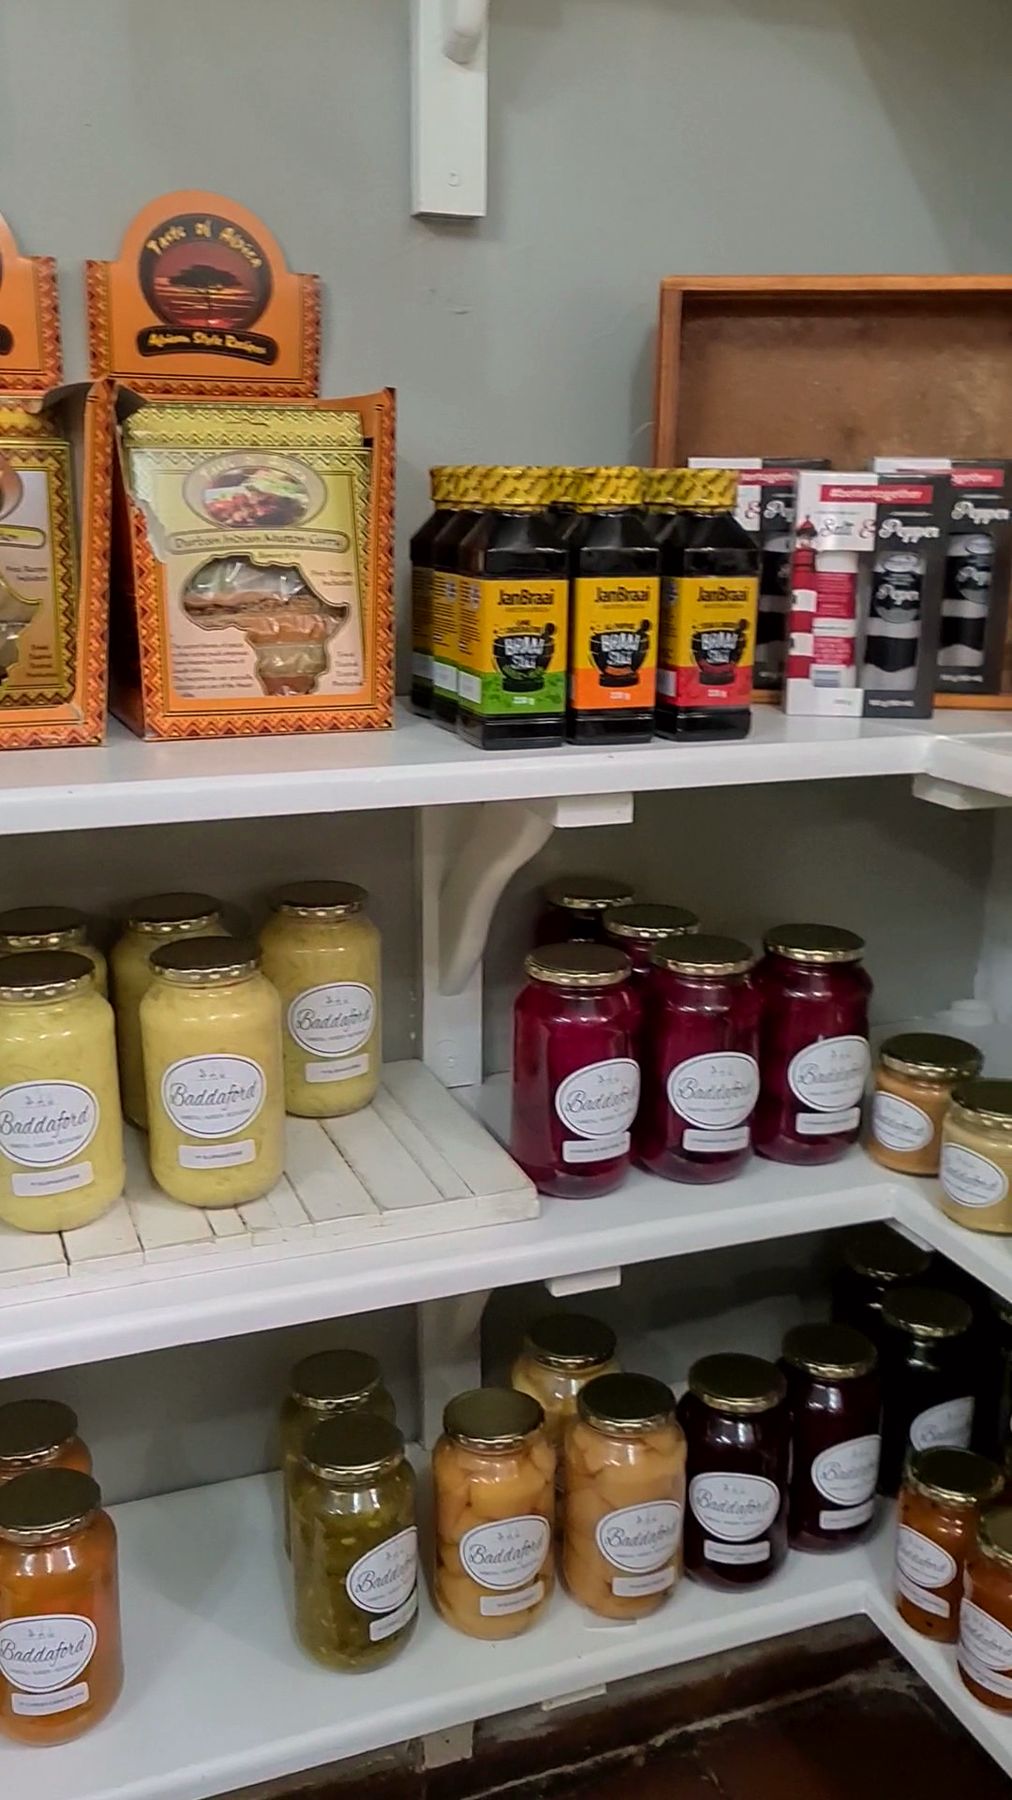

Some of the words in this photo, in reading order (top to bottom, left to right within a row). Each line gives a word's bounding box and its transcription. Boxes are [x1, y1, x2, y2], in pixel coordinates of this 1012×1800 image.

[295, 1004, 372, 1033] Baddaford
[168, 1080, 258, 1111] Baddaford
[0, 1104, 89, 1139] Baddaford
[695, 1487, 772, 1520] Baddaford
[467, 1533, 546, 1566] Baddaford
[0, 1633, 88, 1669] Baddaford
